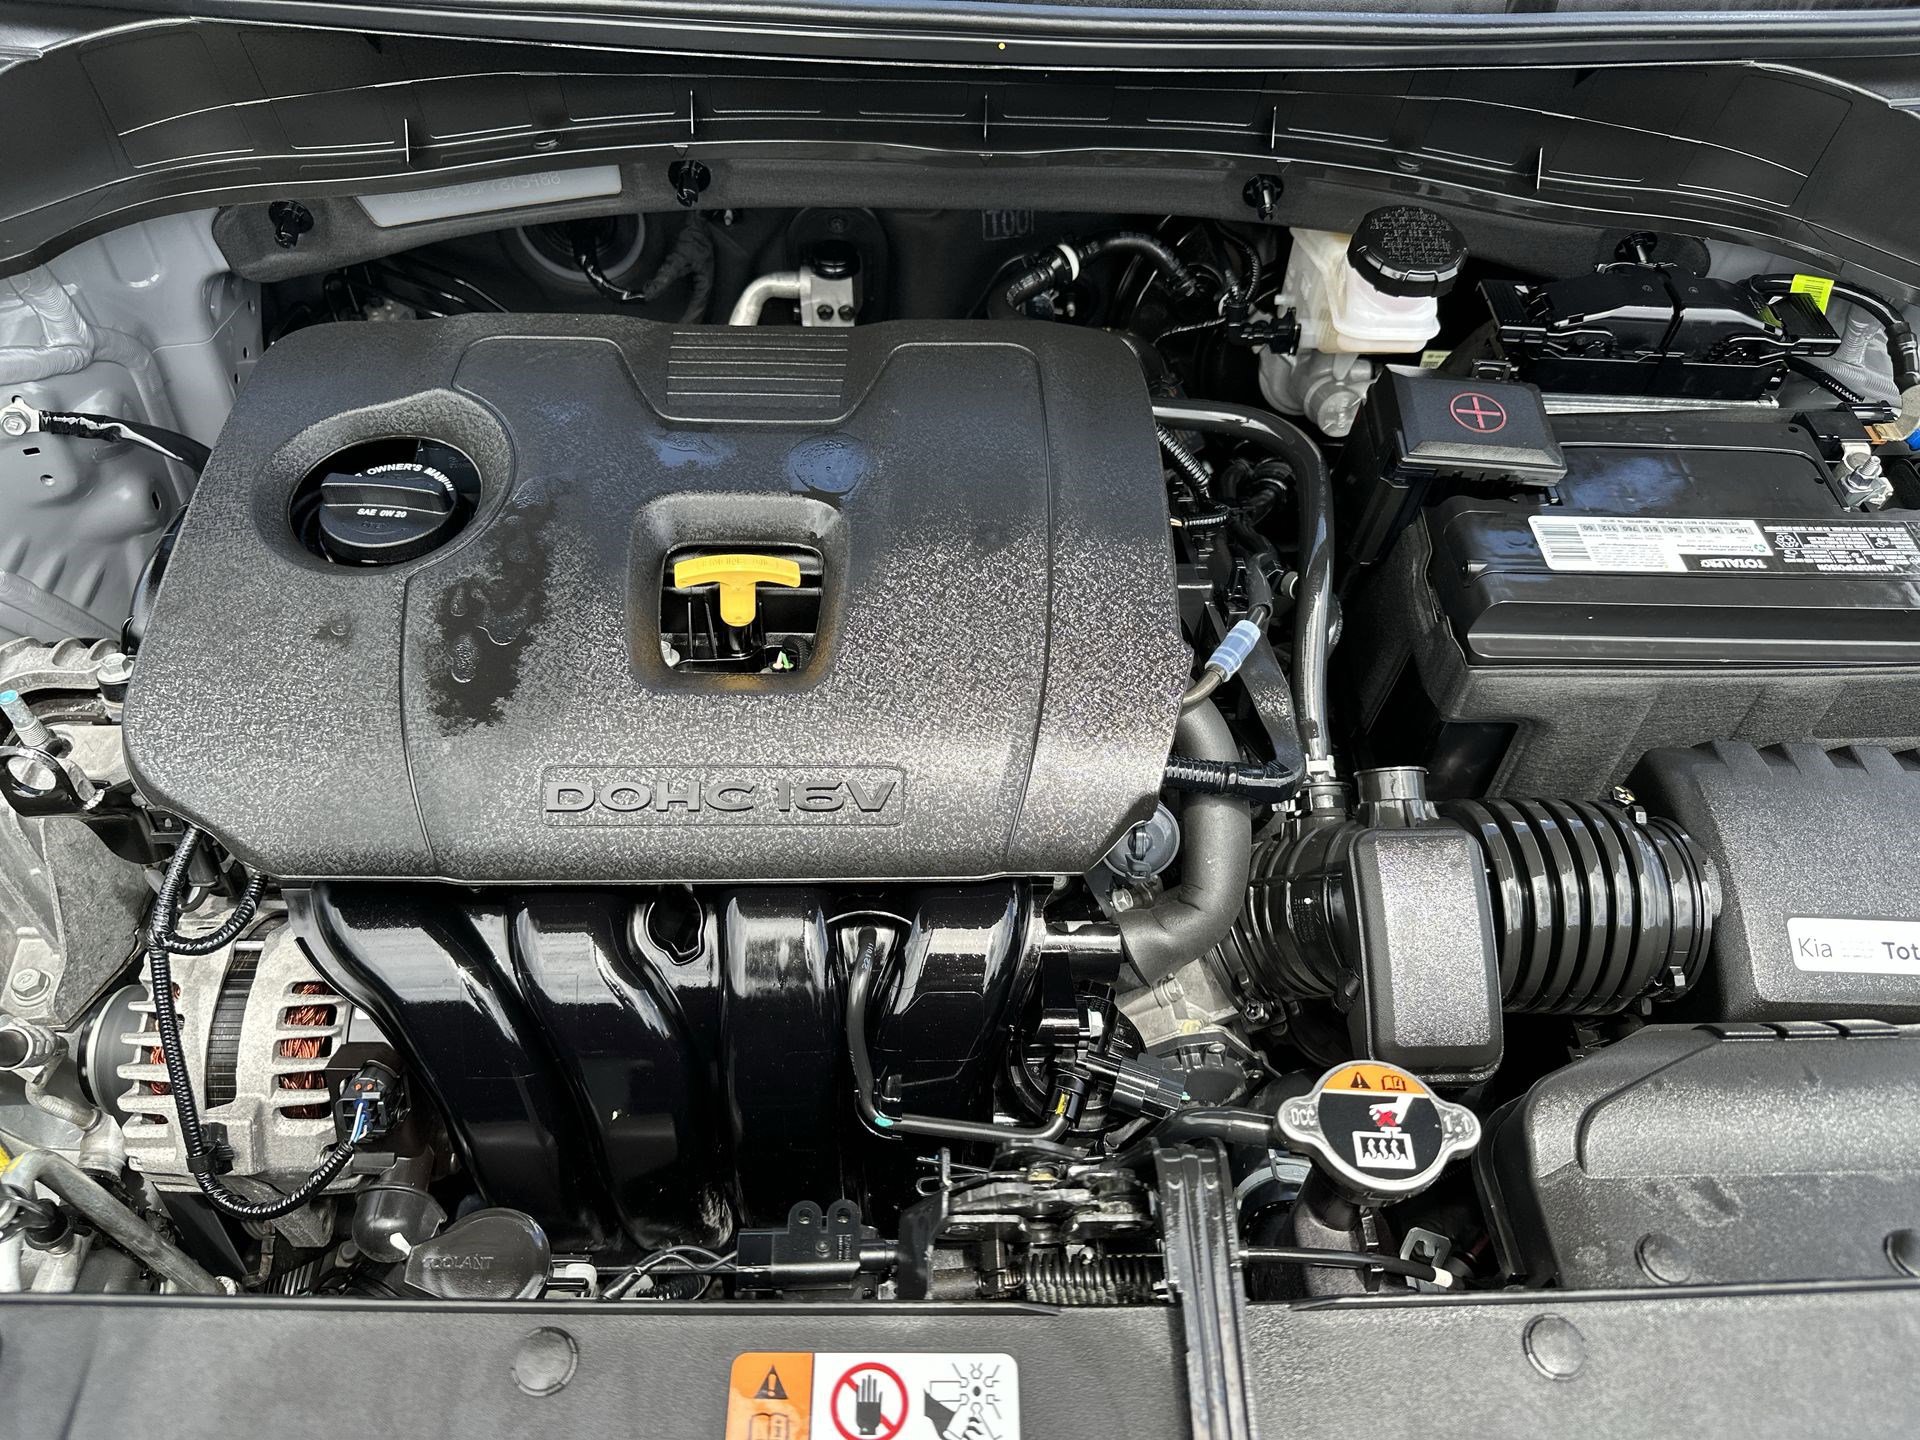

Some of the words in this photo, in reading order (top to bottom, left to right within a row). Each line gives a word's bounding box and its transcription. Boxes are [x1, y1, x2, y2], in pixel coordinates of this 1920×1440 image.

[366, 463, 423, 475] OWNER'S
[357, 508, 376, 516] SAE
[546, 780, 757, 813] DOHC
[775, 780, 897, 813] 16V
[1797, 937, 1833, 958] Kia
[422, 1255, 494, 1270] COOLANT
